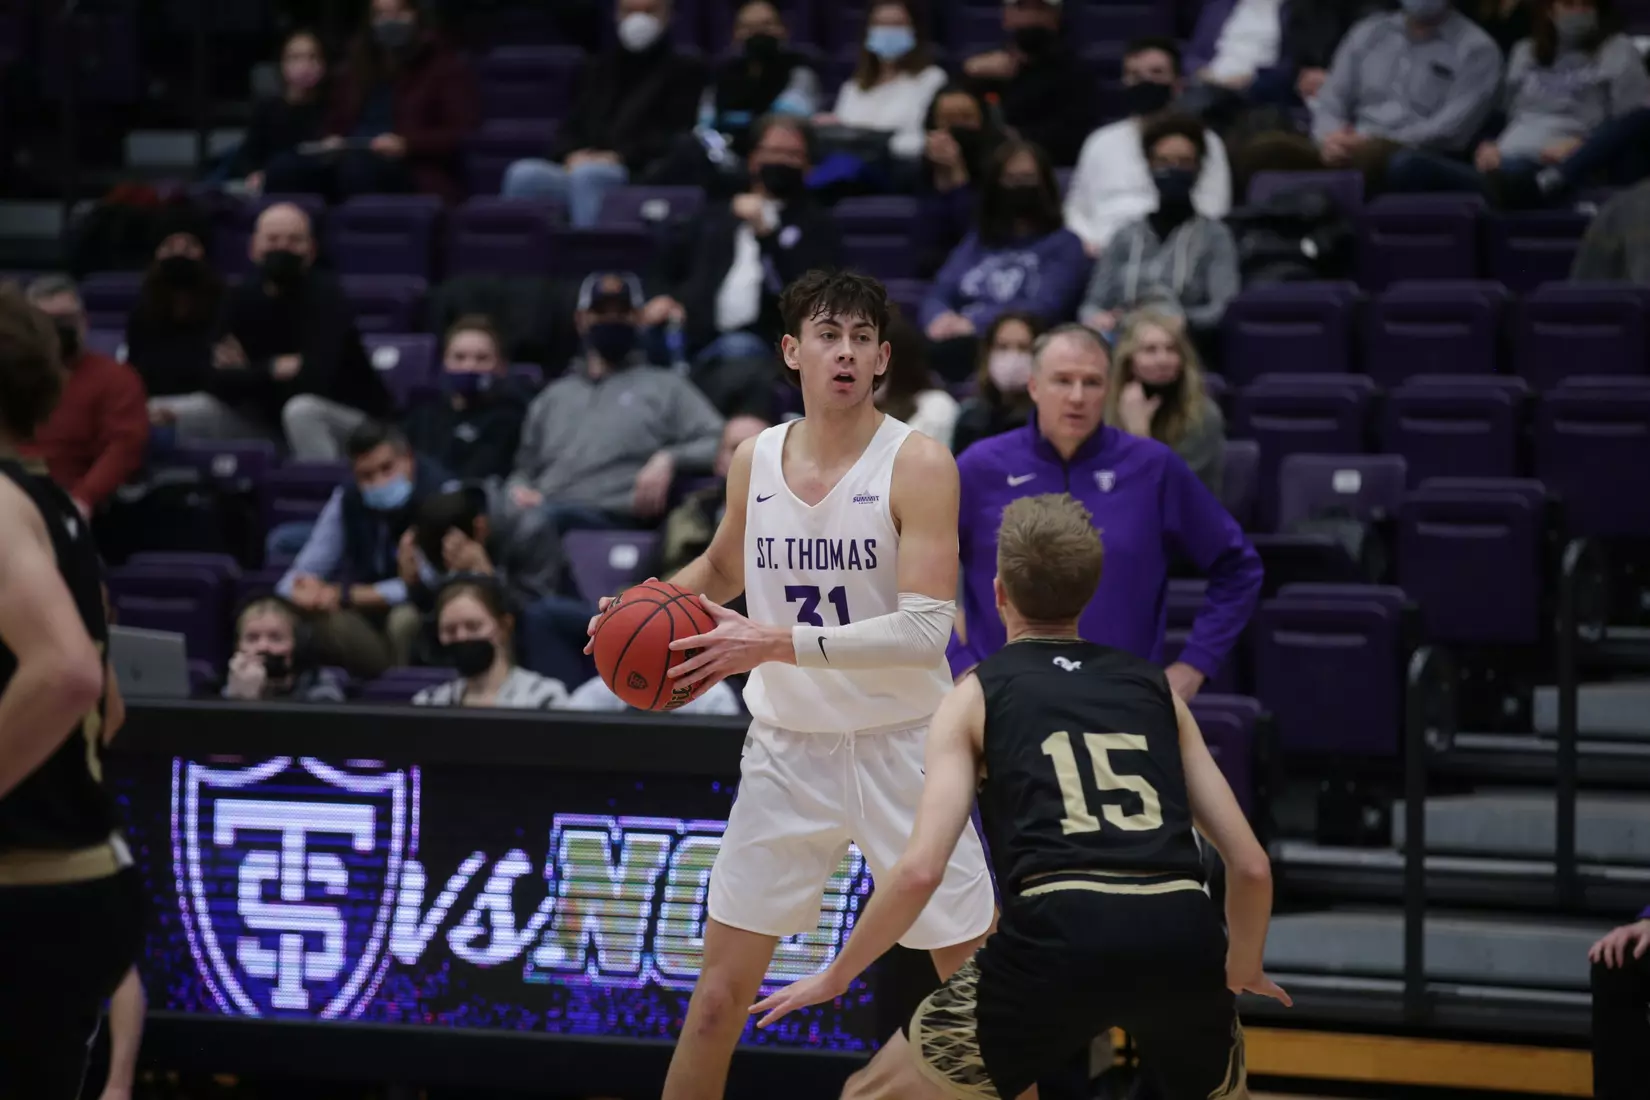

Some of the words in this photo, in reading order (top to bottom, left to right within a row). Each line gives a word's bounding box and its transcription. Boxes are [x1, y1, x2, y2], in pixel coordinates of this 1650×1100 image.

[852, 495, 880, 503] SUMMIT
[756, 537, 779, 569] ST.
[785, 538, 878, 571] THOMAS
[784, 585, 851, 628] 31
[1041, 730, 1164, 836] 15
